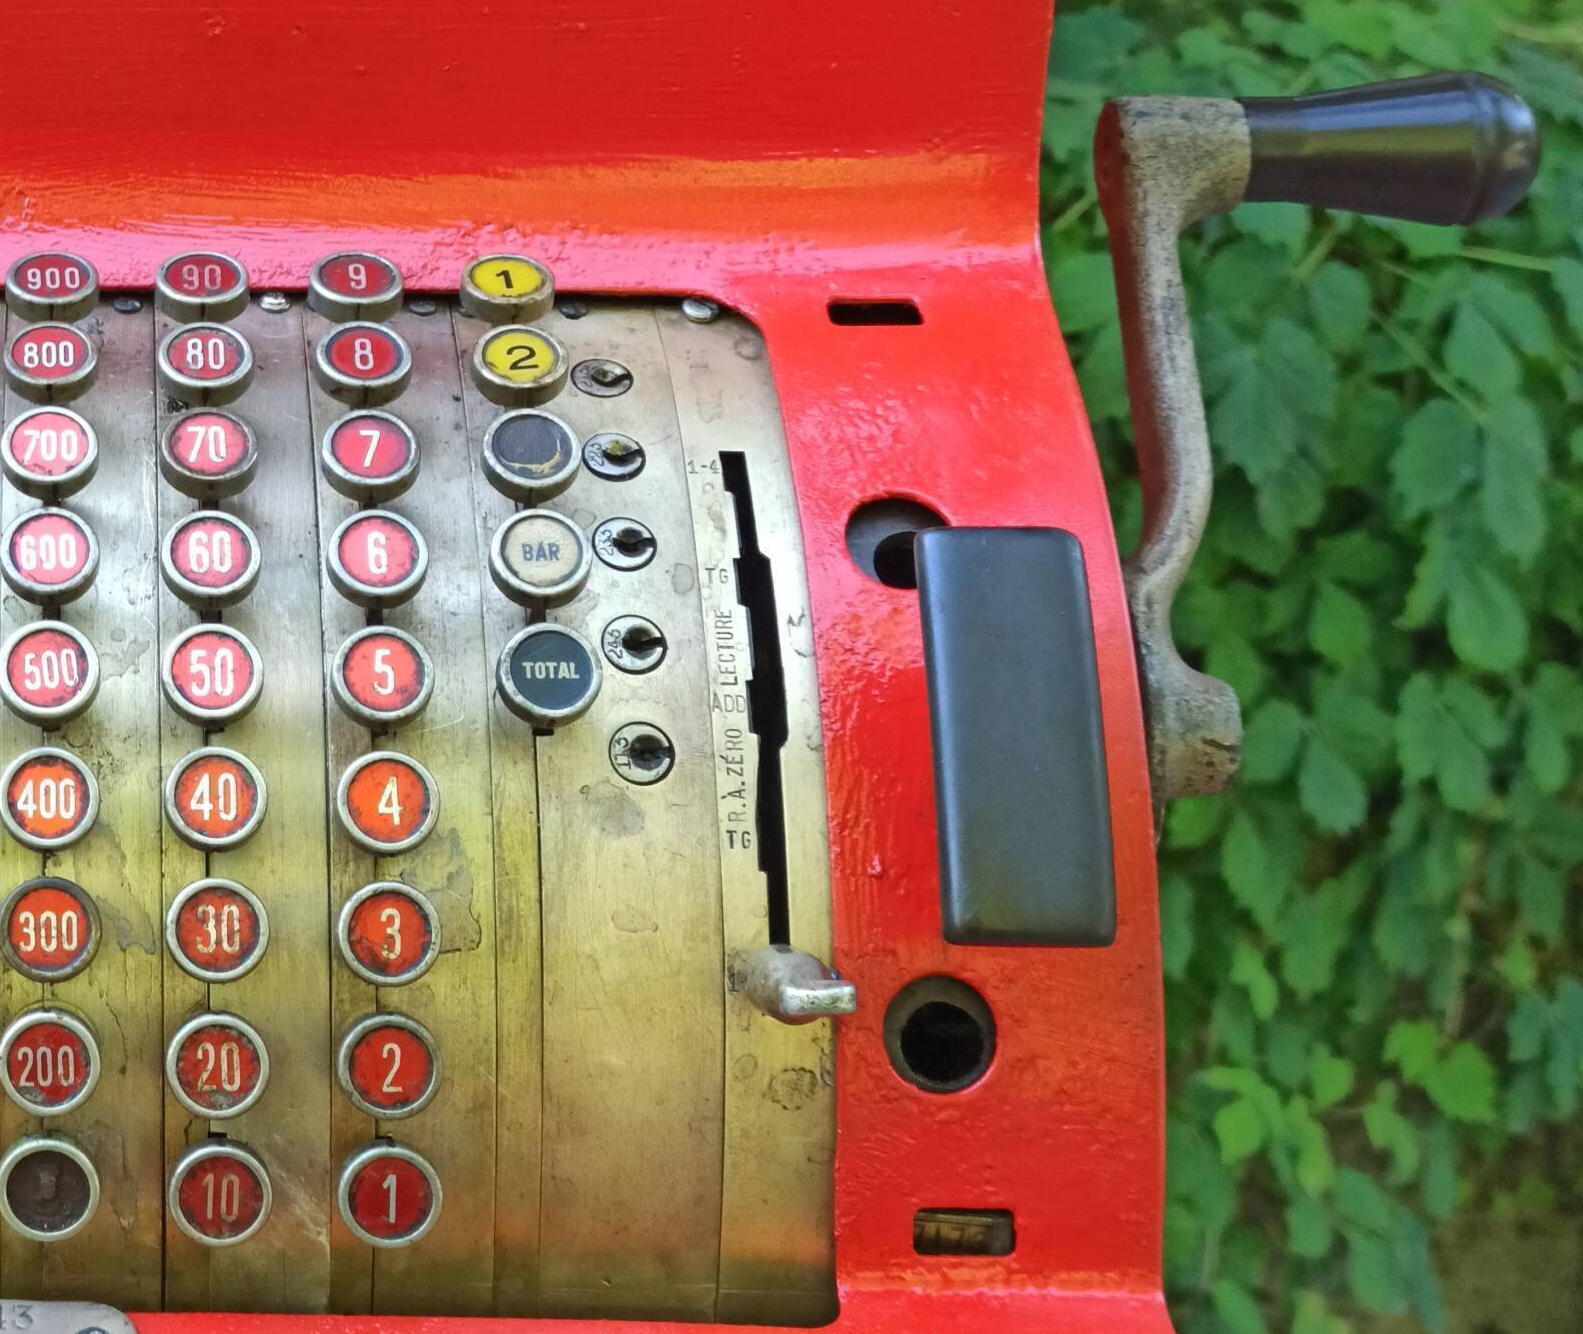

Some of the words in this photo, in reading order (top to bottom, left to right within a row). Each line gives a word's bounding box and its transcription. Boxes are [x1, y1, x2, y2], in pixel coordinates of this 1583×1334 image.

[27, 266, 81, 290] 900
[182, 264, 222, 291] 90
[348, 263, 368, 291] 9
[495, 269, 514, 290] 1
[23, 340, 75, 368] 800
[186, 337, 226, 371] 80
[354, 338, 374, 371] 8
[505, 344, 539, 371] 2
[23, 428, 79, 465] 700
[187, 425, 228, 463] 70
[360, 429, 381, 468] 7
[20, 532, 77, 572] 600
[188, 529, 233, 574] 60
[367, 530, 388, 575] 6
[521, 541, 560, 562] BAR
[716, 608, 739, 687] LECTURE
[24, 648, 79, 691] 500
[189, 647, 234, 697] 50
[373, 648, 395, 695] 5
[521, 661, 580, 680] TOTAL
[712, 692, 747, 713] ADD
[17, 777, 76, 819] 400
[189, 771, 237, 822] 40
[378, 776, 405, 825] 4
[18, 910, 79, 952] 300
[196, 903, 240, 954] 30
[380, 907, 401, 960] 3
[17, 1044, 75, 1088] 200
[196, 1041, 241, 1092] 20
[382, 1042, 403, 1093] 2
[202, 1172, 240, 1223] 10
[382, 1173, 397, 1224] 1
